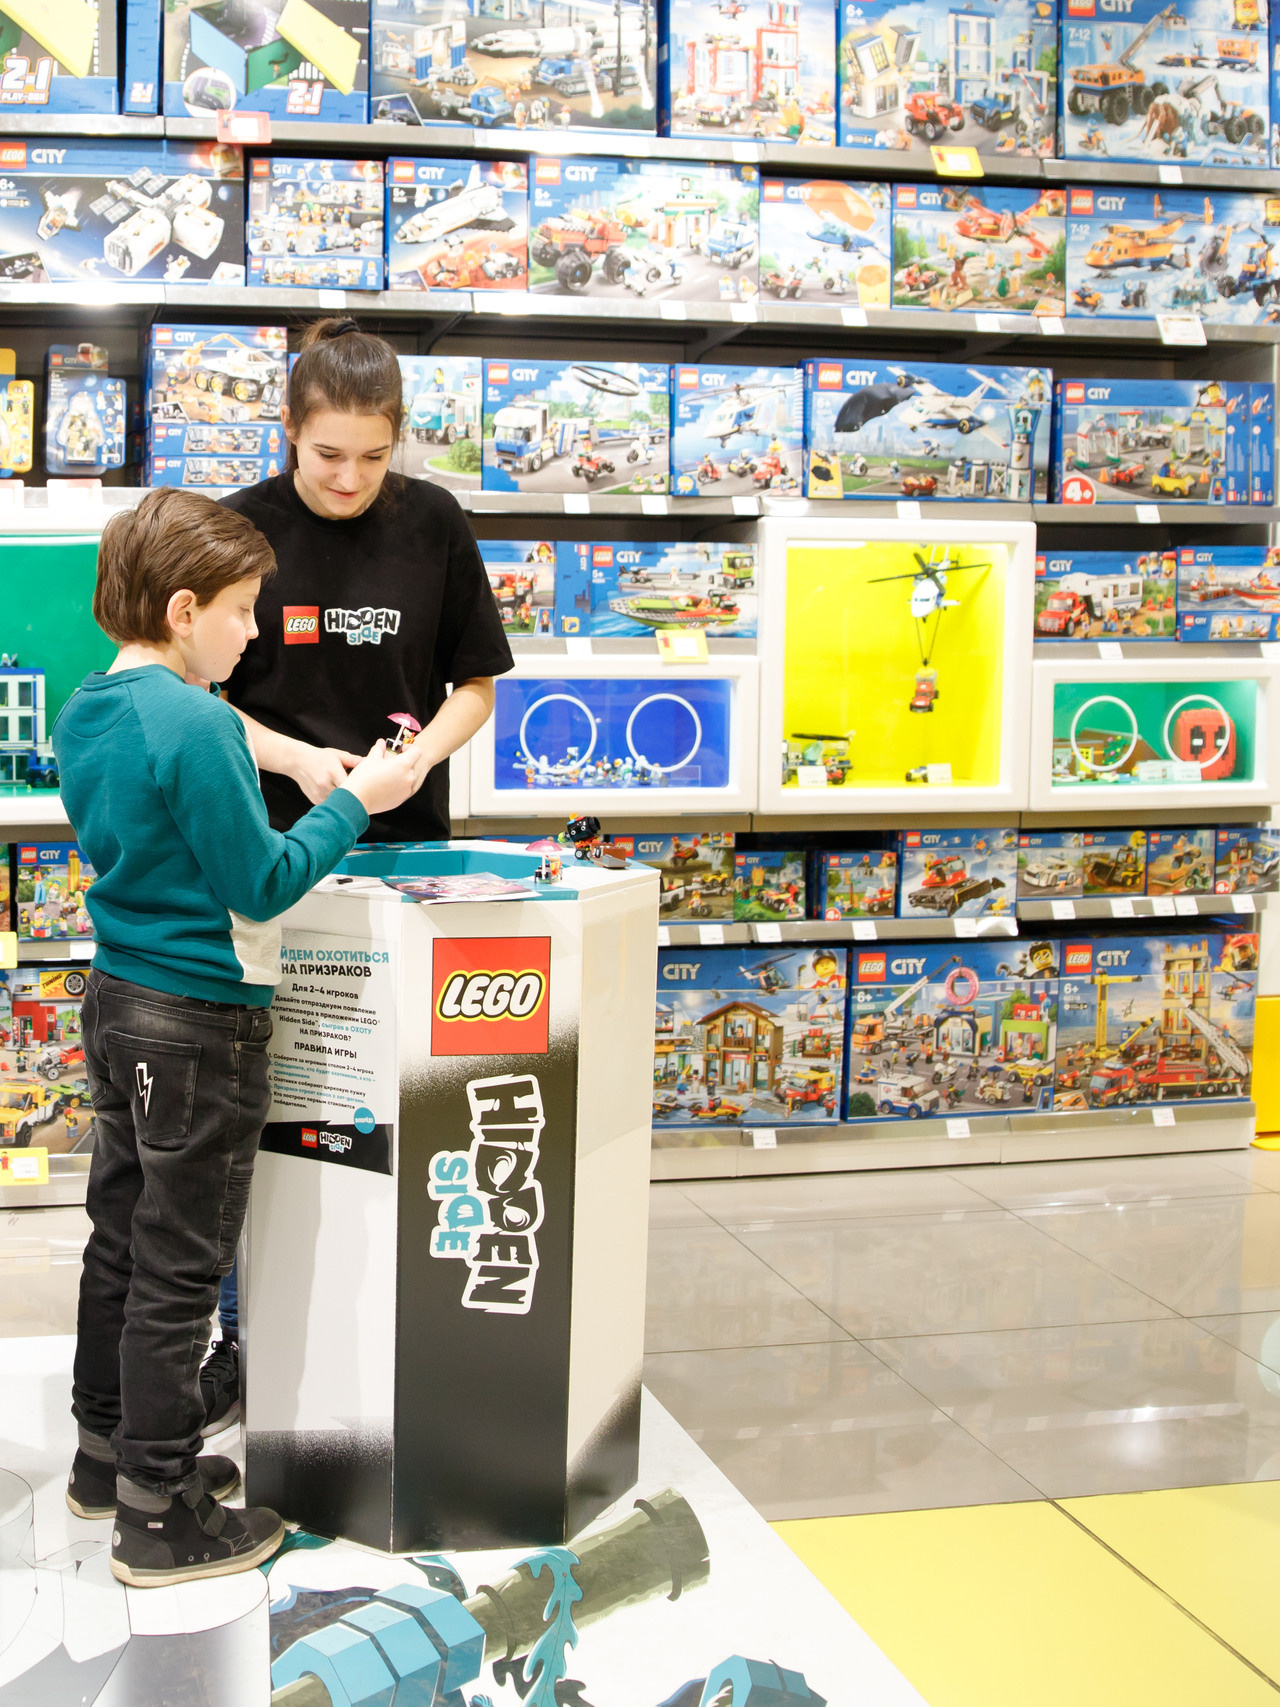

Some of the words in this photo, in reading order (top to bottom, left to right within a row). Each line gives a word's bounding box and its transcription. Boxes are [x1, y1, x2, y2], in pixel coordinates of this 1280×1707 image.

[846, 4, 864, 18] 6+
[1068, 28, 1092, 40] 7-12
[0, 148, 26, 163] LEGO
[31, 148, 66, 164] CITY
[418, 166, 445, 181] CITY
[564, 166, 598, 182] CITY
[0, 178, 15, 190] 6+
[534, 188, 550, 200] 5+
[786, 186, 812, 200] CITY
[919, 192, 942, 205] CITY
[1097, 196, 1126, 212] CITY
[1070, 224, 1090, 234] 7-12
[174, 332, 196, 342] CITY
[512, 368, 540, 382] CITY
[700, 372, 727, 386] CITY
[846, 370, 878, 386] CITY
[488, 387, 500, 396] 5+
[1087, 387, 1112, 400] CITY
[168, 428, 182, 436] CITY
[167, 460, 182, 468] CITY
[1065, 483, 1092, 498] 4+
[592, 552, 613, 562] LEGO
[616, 550, 642, 564] CITY
[1196, 552, 1214, 562] CITY
[1048, 559, 1073, 572] CITY
[592, 570, 604, 578] 5+
[286, 618, 317, 632] LEGO
[326, 610, 398, 632] HIDDEN
[349, 627, 379, 643] SIDE
[922, 834, 941, 844] CITY
[637, 841, 663, 854] CITY
[21, 851, 36, 860] LEGO
[40, 850, 60, 860] CITY
[746, 856, 760, 864] CITY
[840, 856, 853, 865] CITY
[281, 946, 313, 961] ЙДЕМ
[316, 951, 389, 963] ОХОТИТЬСЯ
[1067, 952, 1091, 965] LEGO
[1096, 950, 1132, 968] CITY
[282, 964, 297, 974] НА
[300, 965, 372, 977] ПРИЗРАКОВ
[662, 962, 702, 980] CITY
[860, 960, 884, 974] LEGO
[890, 958, 927, 976] CITY
[42, 972, 63, 989] TUNING
[292, 984, 308, 992] Для
[327, 989, 358, 1000] игроков
[438, 971, 544, 1019] LEGO
[1064, 983, 1080, 995] 6+
[857, 992, 872, 1002] 6+
[275, 995, 300, 1004] Давайте
[301, 1000, 342, 1010] отпразднуем
[343, 1005, 376, 1015] появление
[271, 1005, 314, 1016] мультиплеера
[321, 1013, 359, 1023] приложении
[280, 1015, 300, 1024] Hidden
[322, 1022, 344, 1032] сыграв
[351, 1026, 372, 1035] ОХОТУ
[310, 1030, 351, 1041] ПРИЗРАКОВ?
[295, 1042, 332, 1055] ПРАВИЛА
[335, 1049, 357, 1059] ИГРЫ
[274, 1054, 297, 1063] Соберите
[274, 1076, 297, 1085] Охотники
[298, 1081, 322, 1090] собирают
[320, 1132, 352, 1149] HIDDEN
[467, 1078, 543, 1309] HIDDEN
[433, 1155, 484, 1253] SIDE
